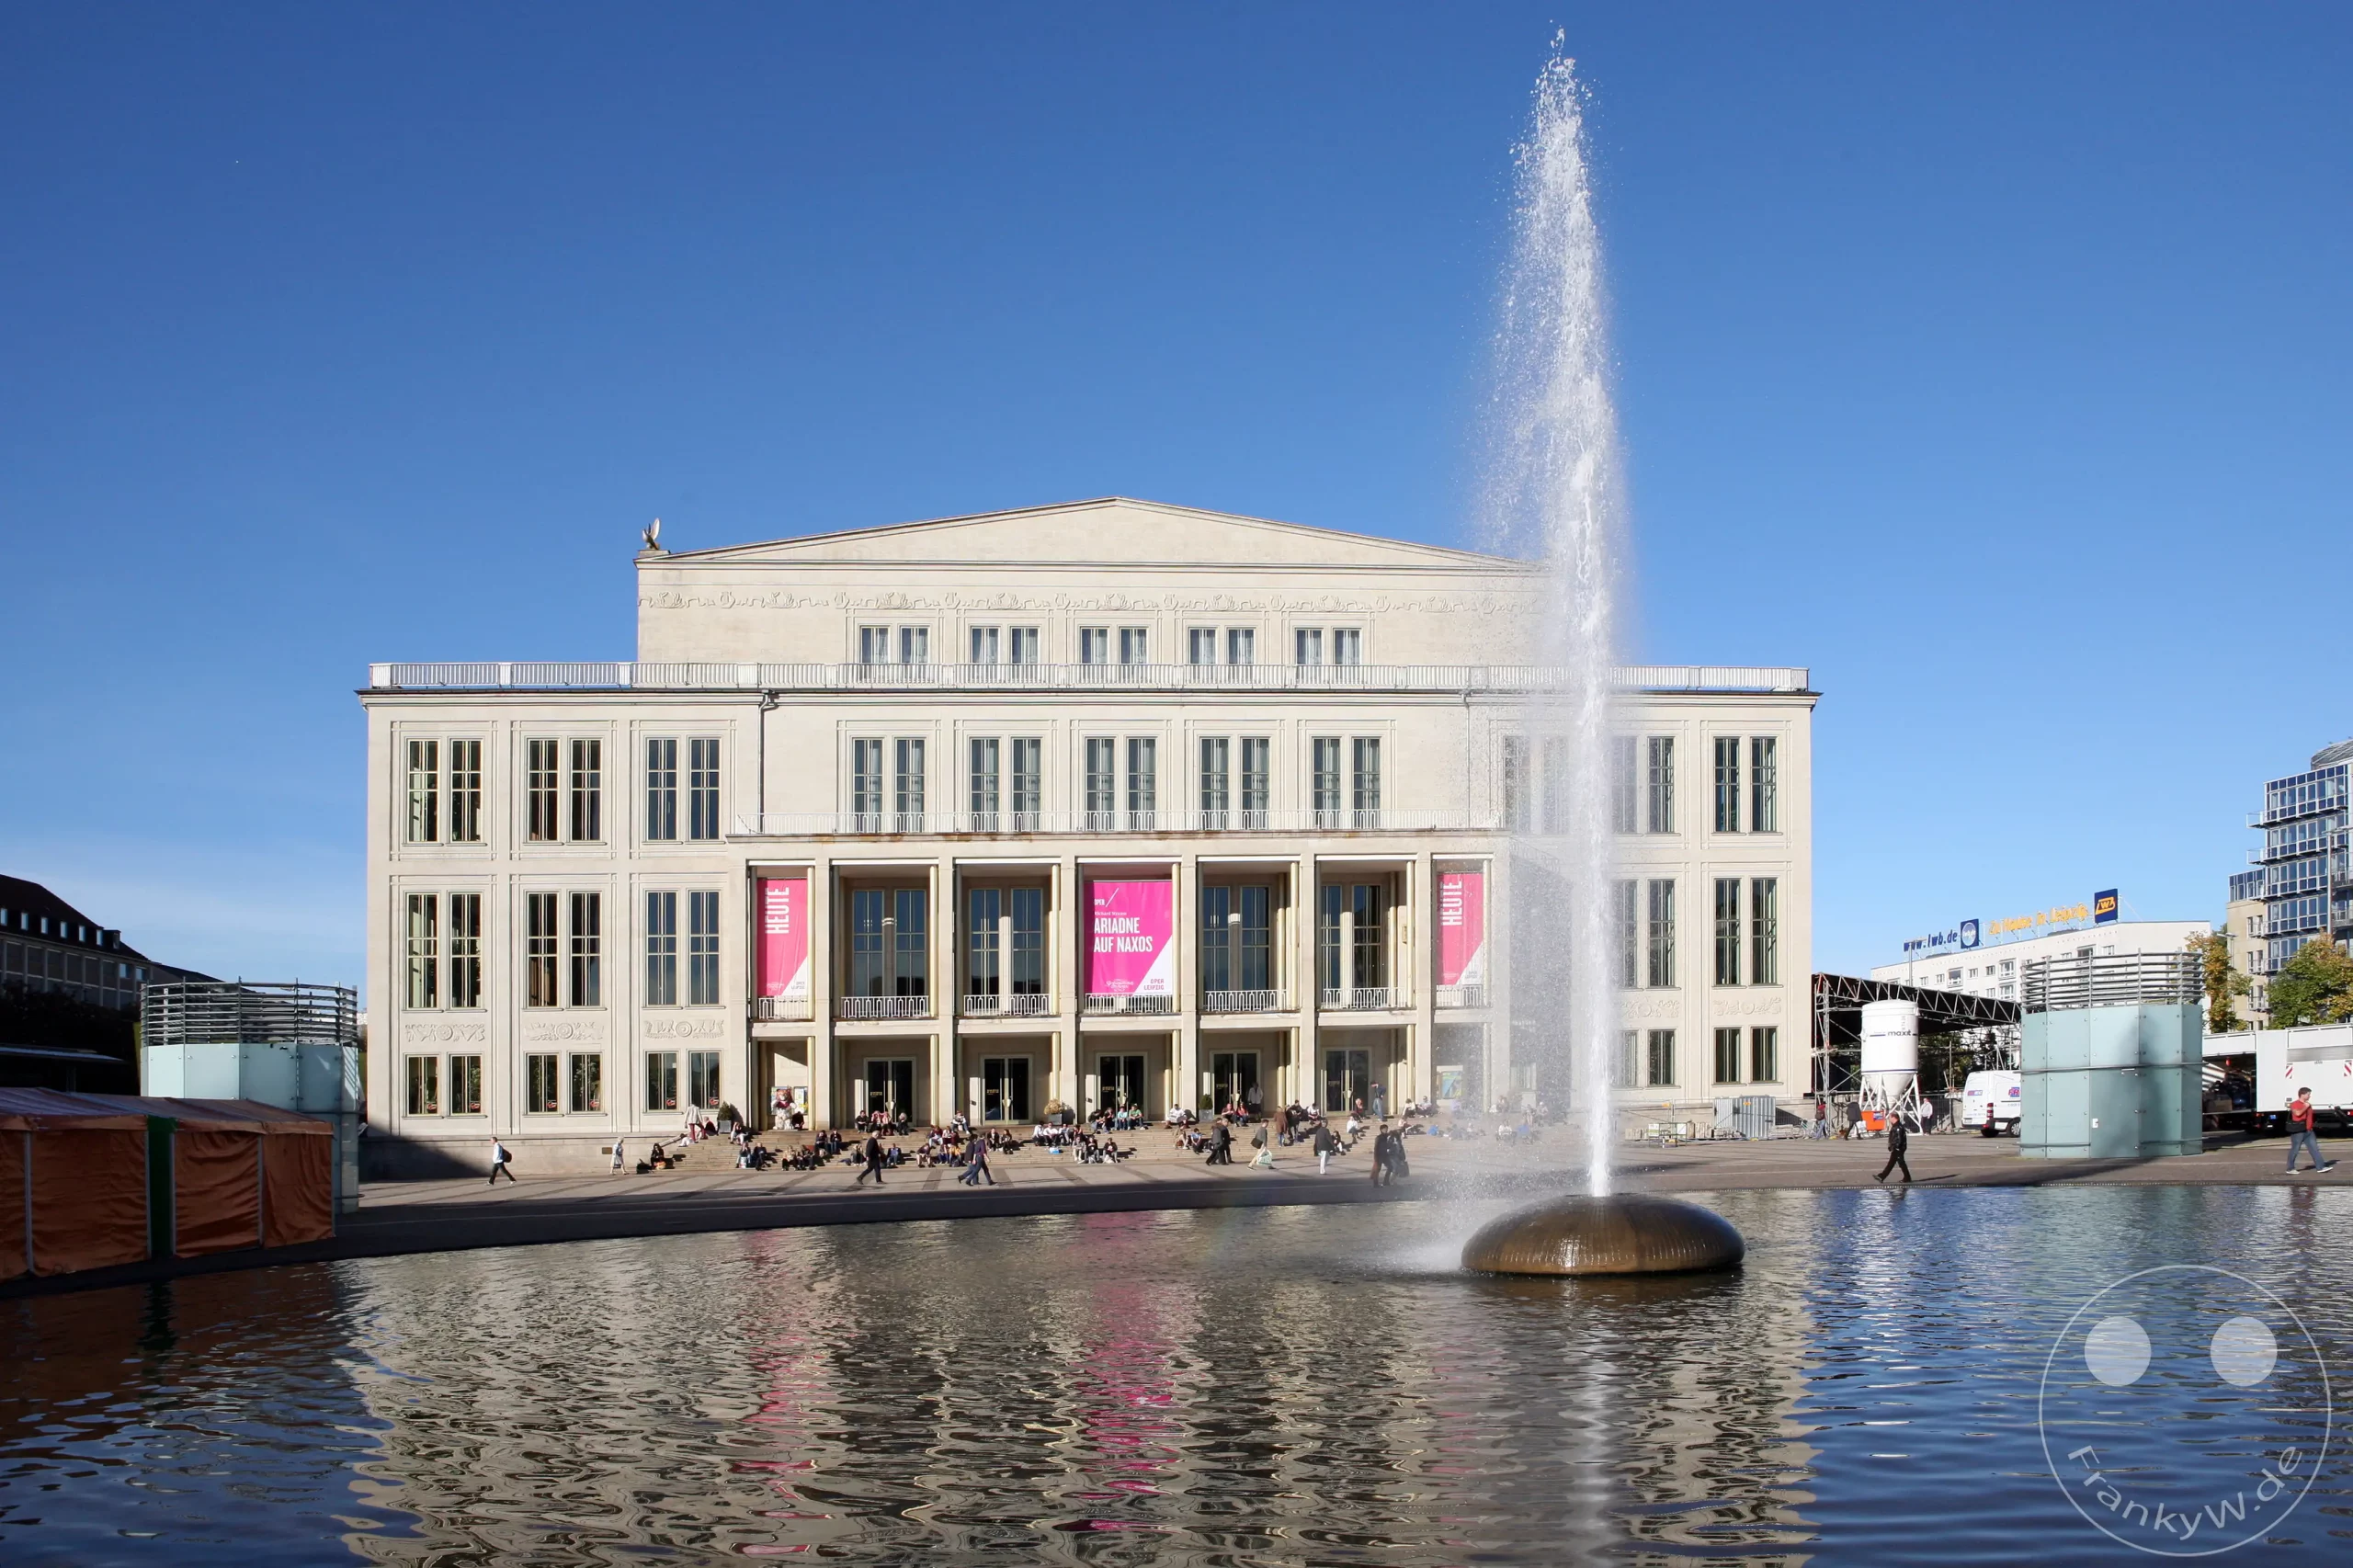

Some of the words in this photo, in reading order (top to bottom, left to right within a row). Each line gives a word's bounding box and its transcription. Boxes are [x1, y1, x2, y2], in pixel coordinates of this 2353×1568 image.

[764, 887, 790, 934] HEUTE
[1439, 881, 1462, 926] HEUTE
[1094, 917, 1140, 934] ARIADNE
[1094, 937, 1114, 952] AUF
[1117, 936, 1153, 952] NAXOS
